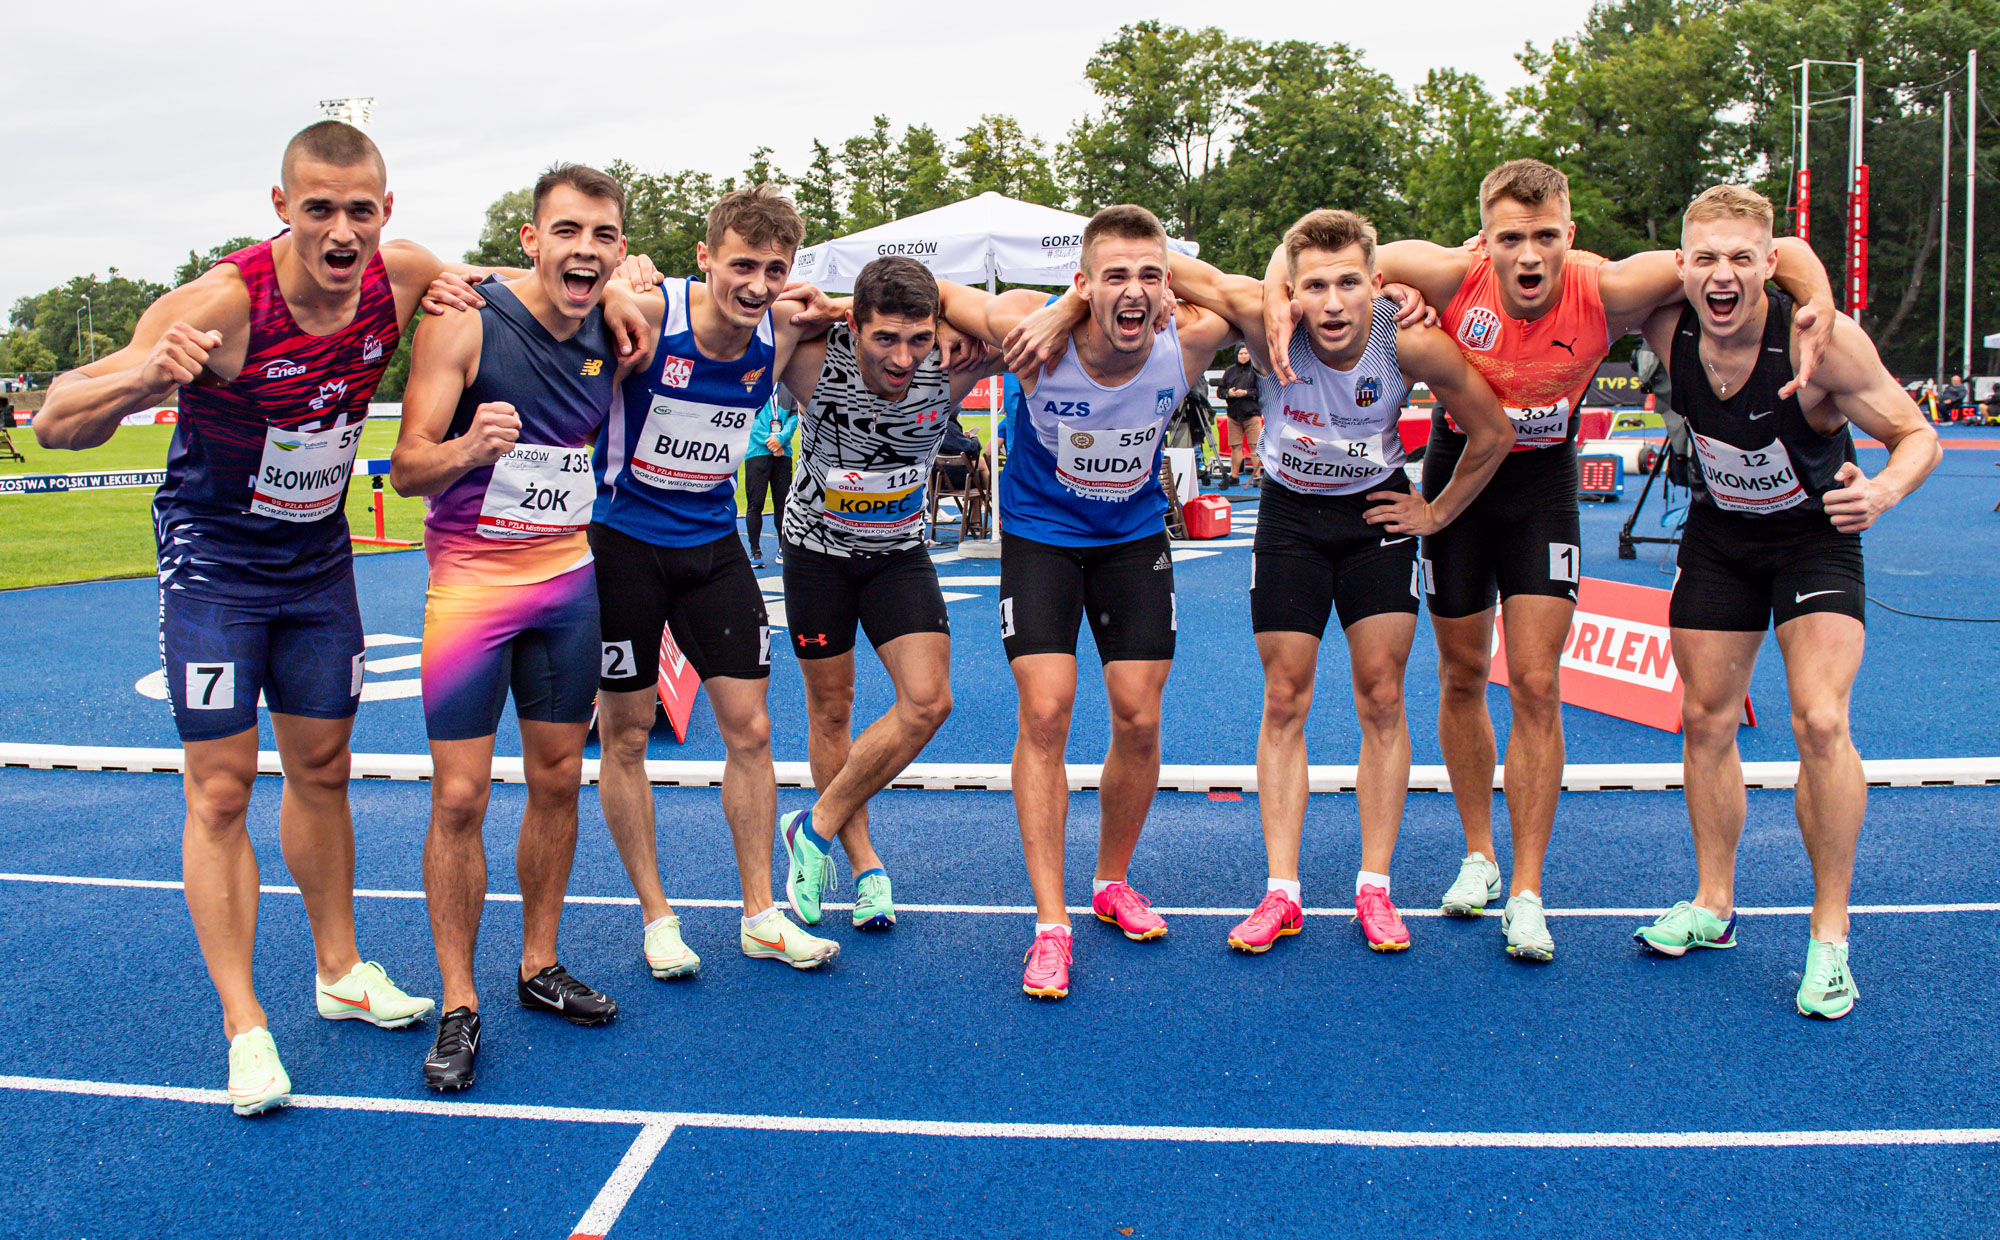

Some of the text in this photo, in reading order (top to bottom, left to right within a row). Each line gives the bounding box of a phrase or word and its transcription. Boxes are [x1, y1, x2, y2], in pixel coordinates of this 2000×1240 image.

[877, 240, 938, 256] GORZÓW
[266, 365, 307, 379] Enea
[1596, 377, 1628, 390] TVP
[1043, 400, 1091, 417] AZS
[1283, 405, 1326, 428] MKL
[710, 410, 747, 430] 458
[1119, 427, 1156, 447] 550
[654, 434, 730, 464] BURDA
[560, 453, 590, 473] 135
[1073, 456, 1142, 474] SIUDA
[1740, 453, 1770, 467] 12
[50, 477, 87, 488] POLSKI
[90, 476, 101, 487] W
[103, 474, 142, 486] LEKKIEJ
[634, 469, 666, 484] GORZÓW
[886, 468, 919, 490] 112
[1583, 462, 1613, 490] 00
[520, 481, 571, 512] ŻOK
[840, 494, 911, 515] KOPEĆ
[257, 504, 298, 518] GORZÓW
[495, 519, 507, 528] 99.
[508, 521, 525, 530] PZLA
[526, 525, 561, 533] Mistrzostwa
[1560, 547, 1574, 578] 1
[604, 645, 628, 676] 2
[196, 666, 225, 706] 7
